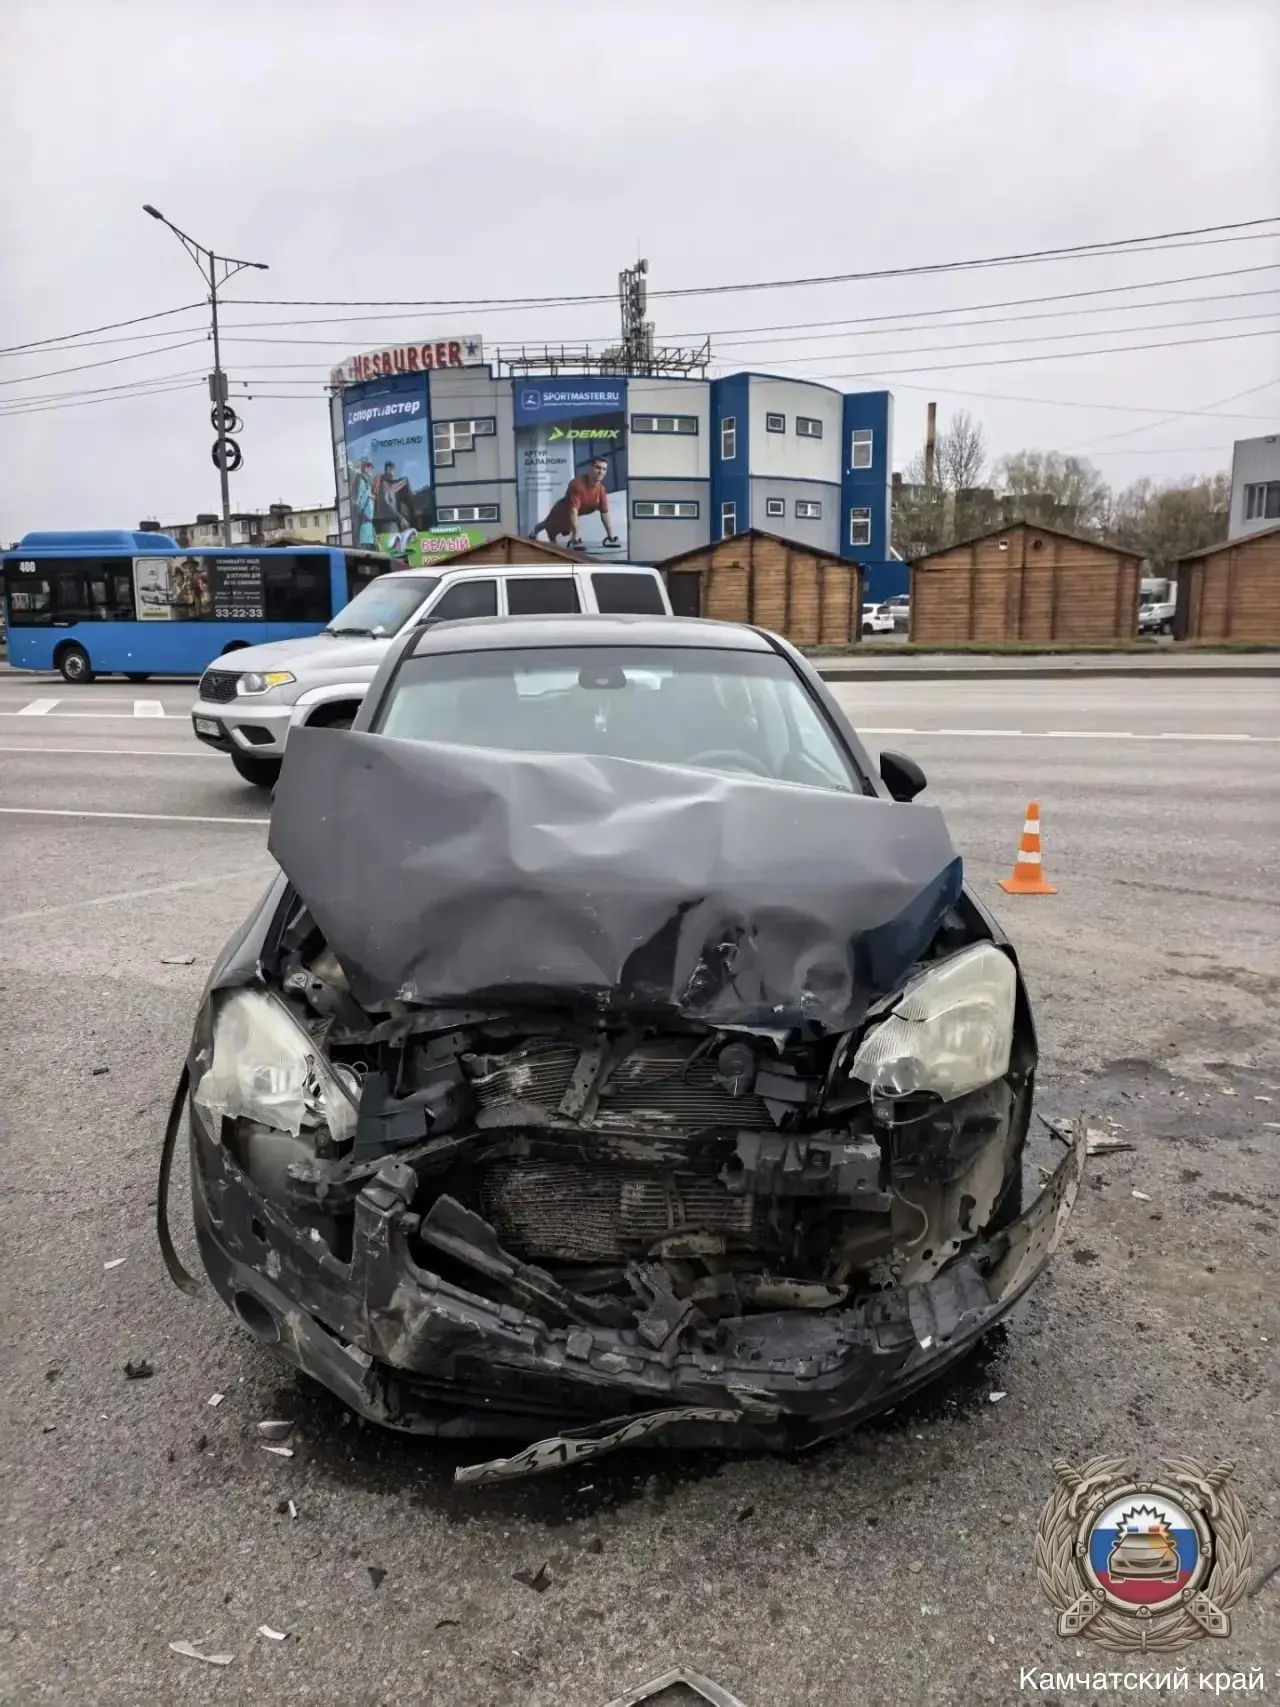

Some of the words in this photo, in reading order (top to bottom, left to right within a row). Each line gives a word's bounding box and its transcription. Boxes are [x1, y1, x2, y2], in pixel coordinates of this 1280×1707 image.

[353, 341, 462, 380] HESBURGER
[543, 392, 619, 401] SPORTMASTER.RU
[566, 430, 620, 439] DEMIX
[379, 436, 422, 448] NORTHLAND
[421, 534, 470, 552] БЕЛЫЙ
[20, 561, 36, 573] 400
[215, 608, 263, 618] 33-22-33
